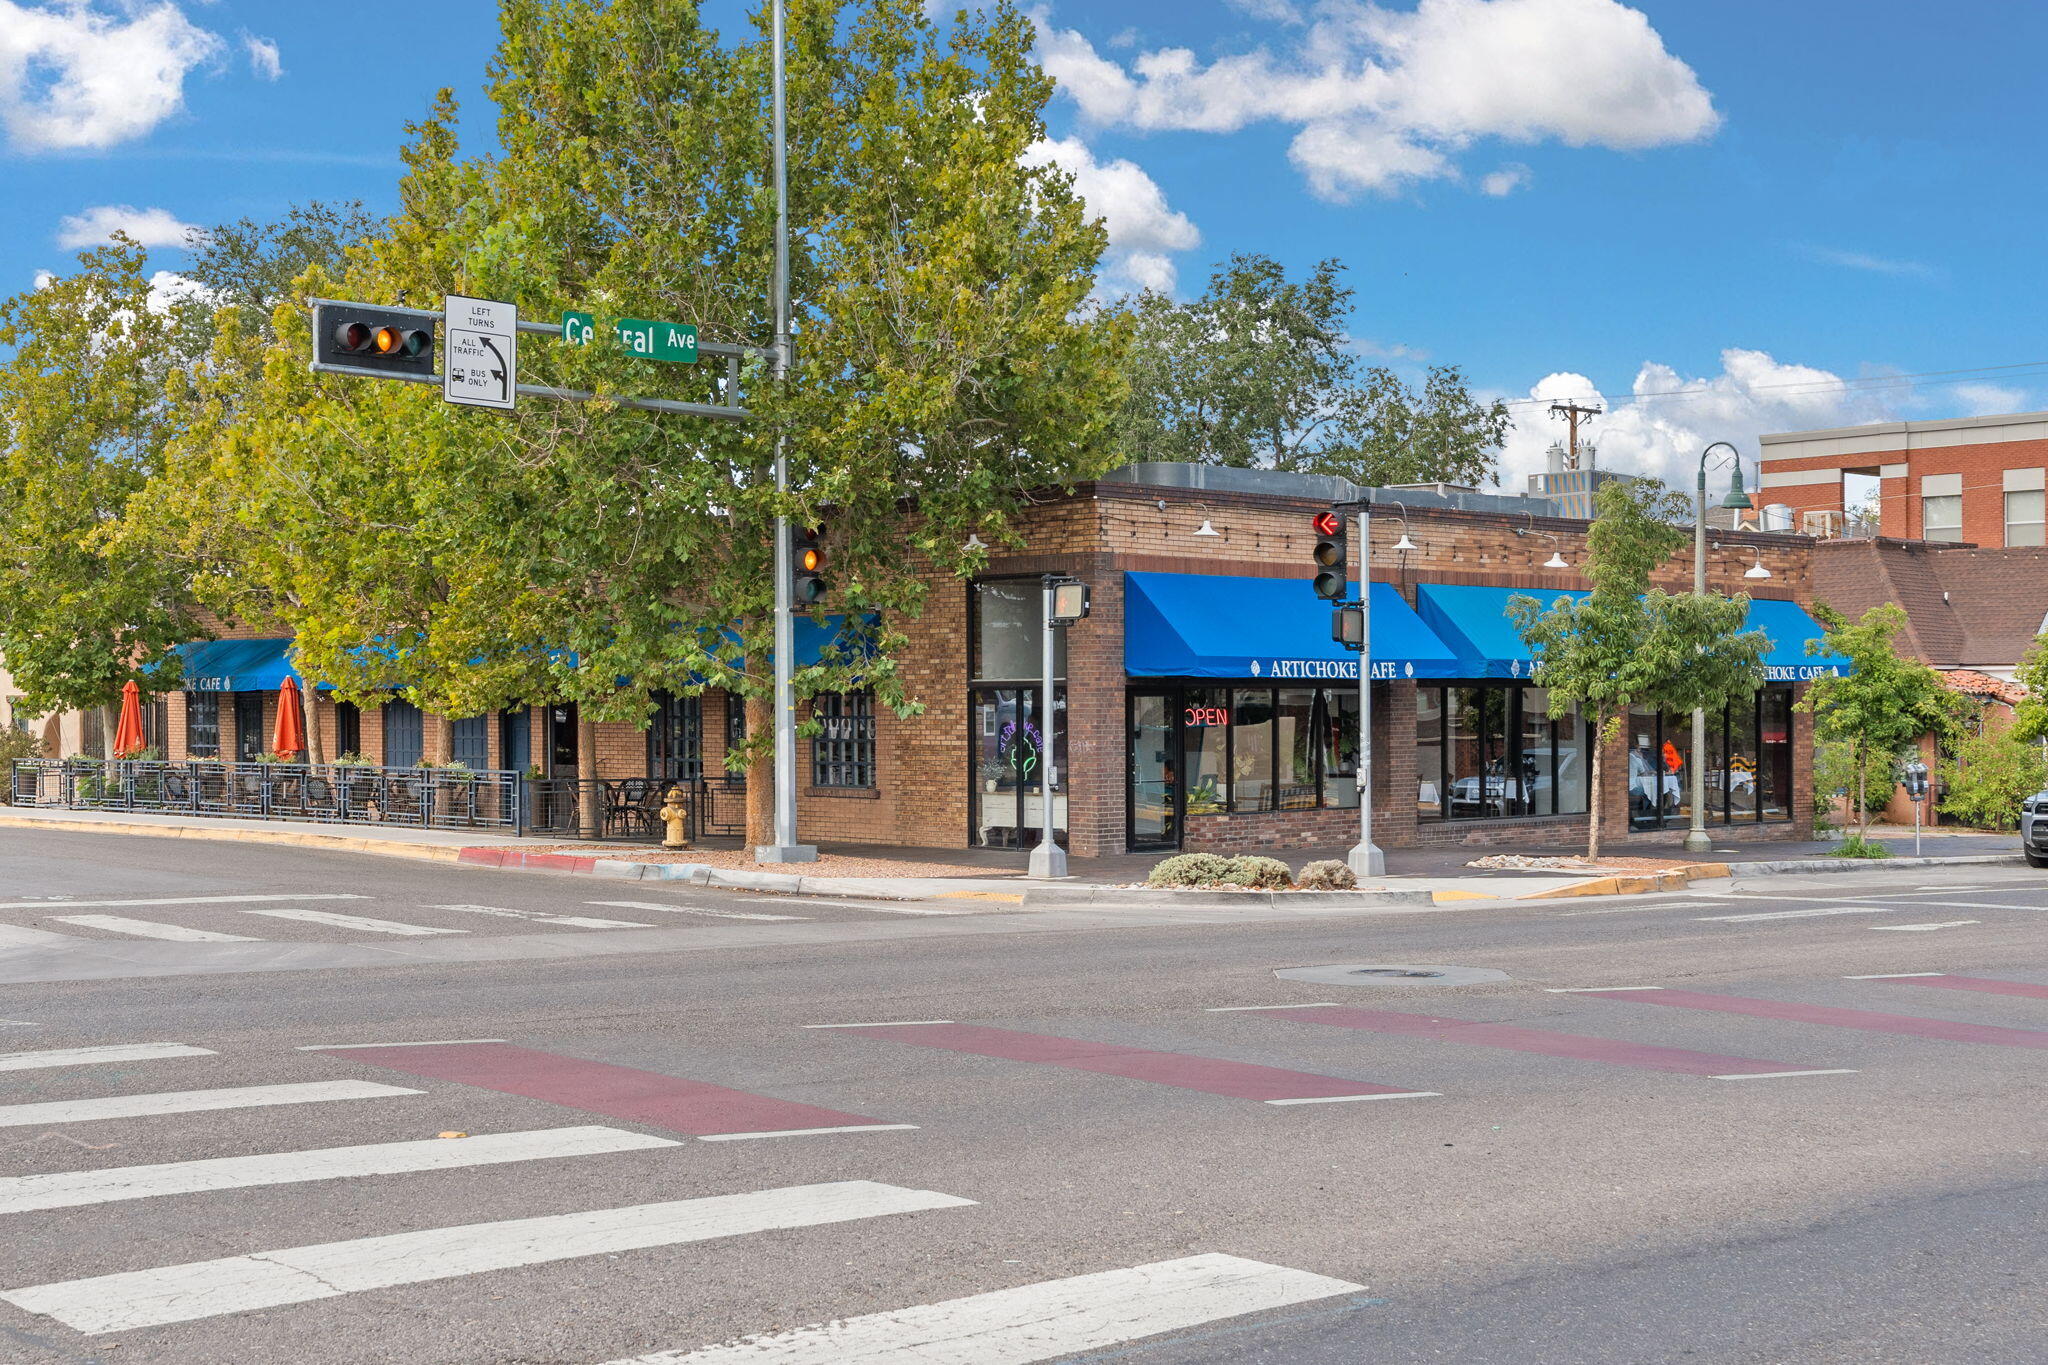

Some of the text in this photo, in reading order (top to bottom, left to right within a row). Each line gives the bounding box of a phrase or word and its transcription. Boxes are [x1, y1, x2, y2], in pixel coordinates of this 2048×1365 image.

[472, 306, 491, 317] LEFT
[468, 318, 495, 328] TURNS
[566, 317, 695, 353] Ceral Ave
[461, 338, 476, 347] ALL
[453, 346, 484, 357] TRAFFIC
[470, 369, 486, 378] BUS
[468, 378, 488, 387] ONLY
[1270, 660, 1397, 679] ARTICHOKE AFE
[200, 677, 221, 690] CAFE
[1185, 708, 1228, 726] OPEN
